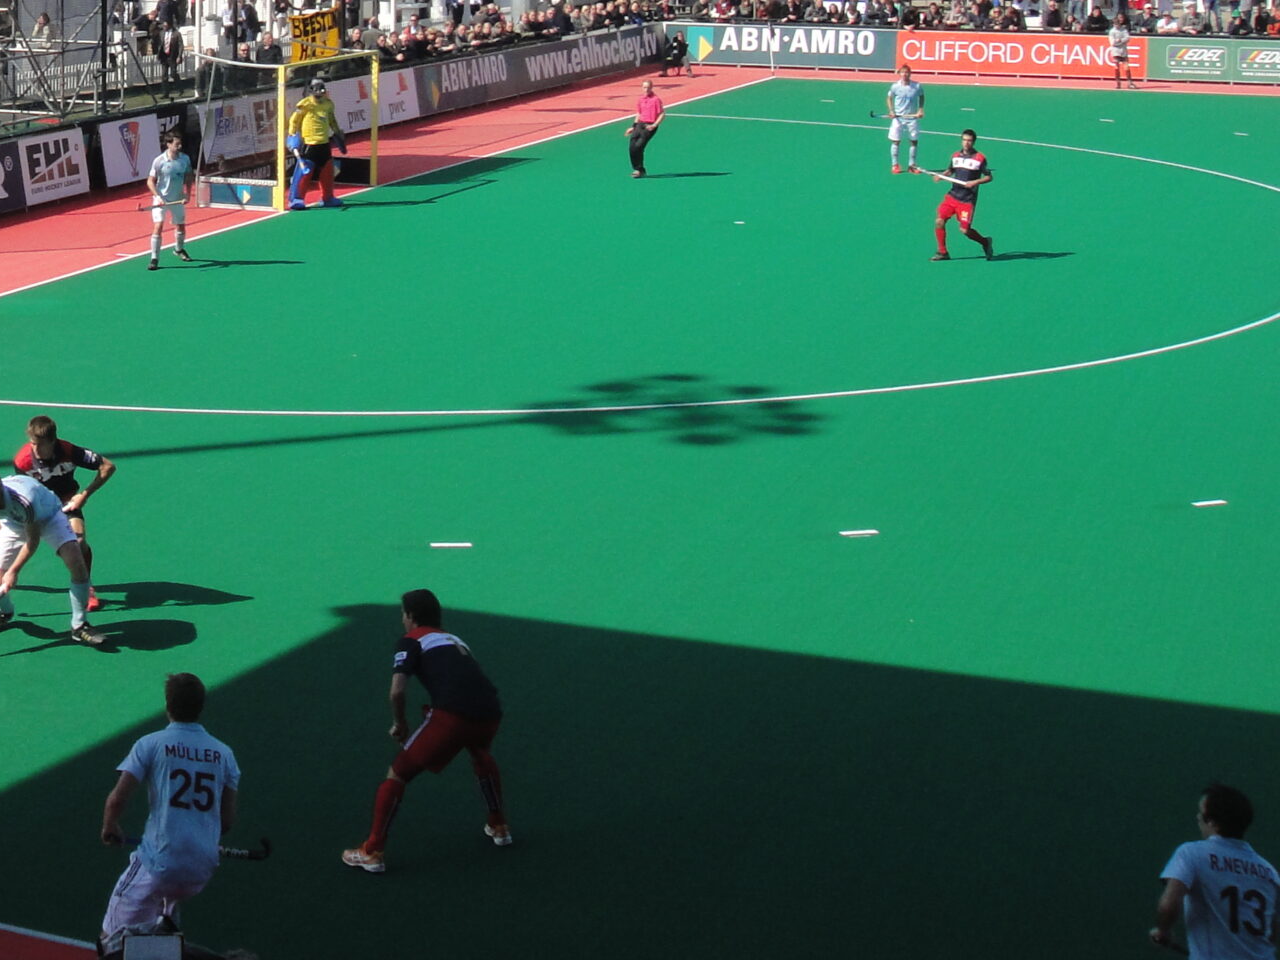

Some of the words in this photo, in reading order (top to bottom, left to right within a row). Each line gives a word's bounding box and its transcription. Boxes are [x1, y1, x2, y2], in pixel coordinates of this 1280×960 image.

[525, 30, 657, 82] www.ehlhockey.tv
[902, 39, 1024, 64] CLIFFORD
[346, 109, 367, 129] pwc
[387, 100, 406, 120] pwc
[25, 137, 80, 185] EHL
[164, 741, 222, 765] MÜLLER
[169, 768, 216, 812] 25
[1220, 885, 1266, 936] 13
